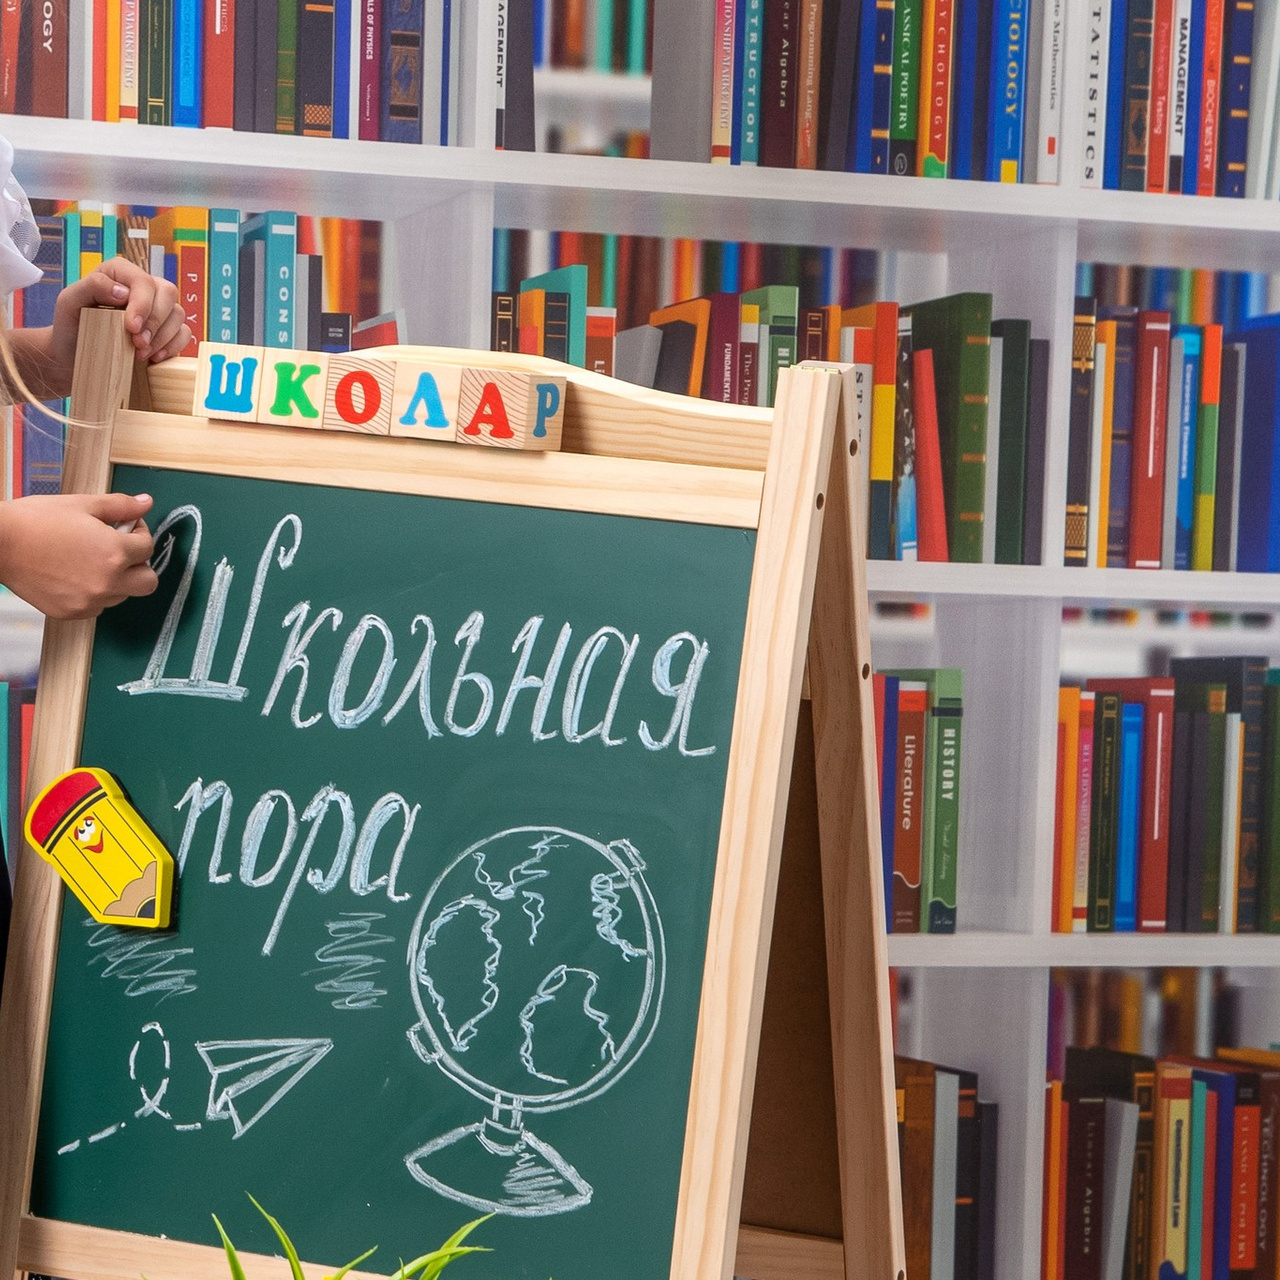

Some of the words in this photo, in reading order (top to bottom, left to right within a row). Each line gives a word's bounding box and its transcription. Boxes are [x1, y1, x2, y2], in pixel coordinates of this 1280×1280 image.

[124, 12, 136, 90] MARKETING
[365, 23, 374, 61] PHYSICS
[779, 38, 790, 110] Algebra
[806, 2, 817, 87] Programming
[1050, 19, 1062, 110] Mathematics
[1174, 17, 1190, 136] MANAGEMENT
[719, 48, 731, 130] MARKETING
[898, 70, 910, 131] POETRY
[742, 351, 753, 374] The
[117, 503, 717, 758] Школьная
[901, 734, 916, 831] Literature
[941, 727, 956, 801] HISTORY
[175, 776, 422, 956] пора
